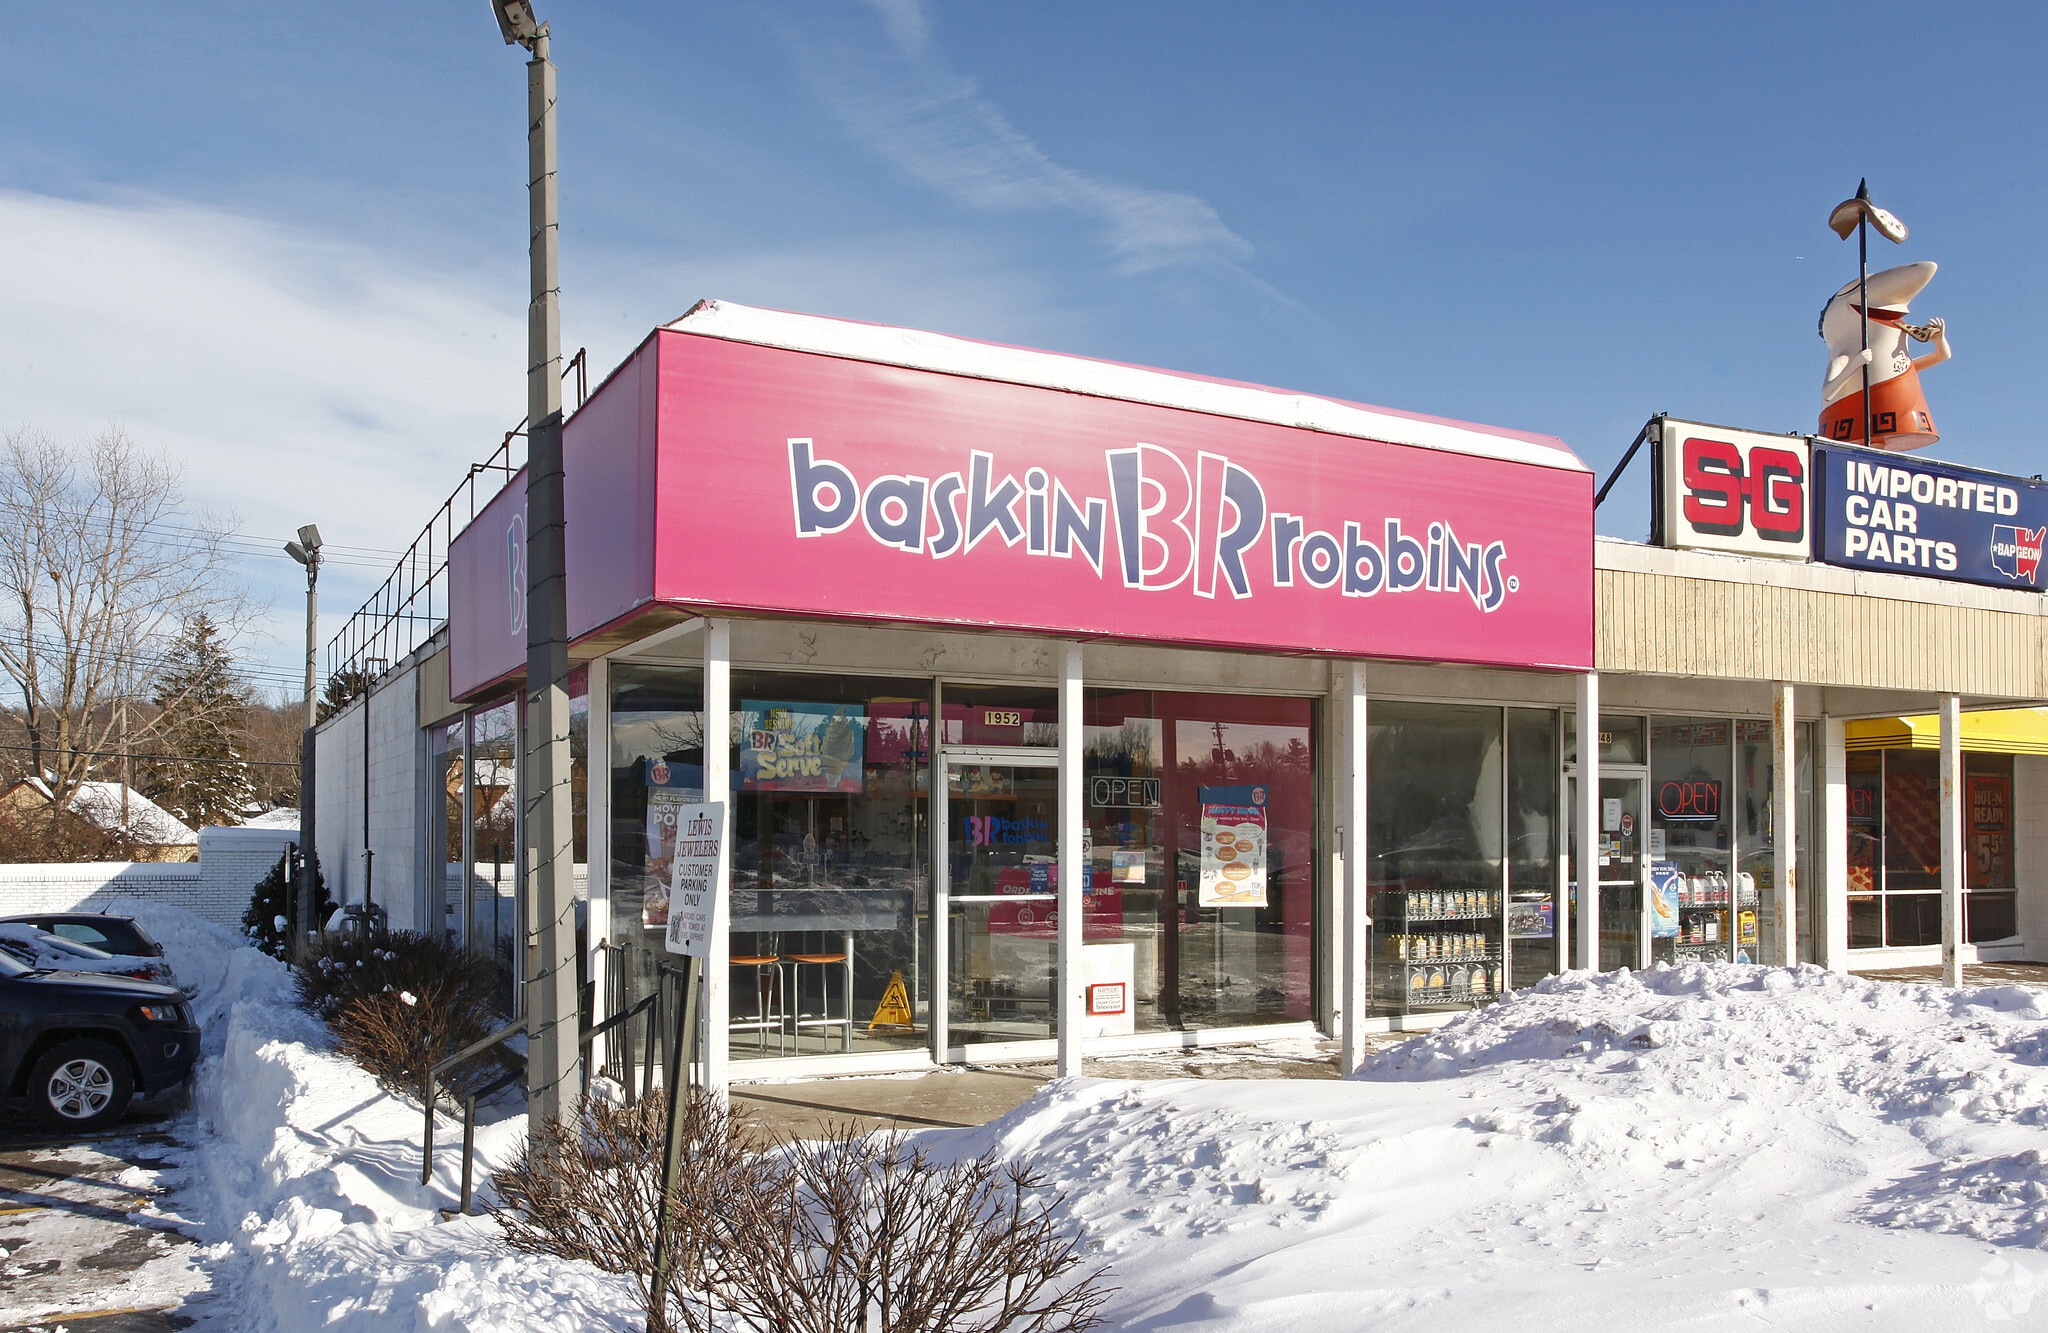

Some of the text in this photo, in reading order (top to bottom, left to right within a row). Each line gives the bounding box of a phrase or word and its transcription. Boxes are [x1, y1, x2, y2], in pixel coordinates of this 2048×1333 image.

[1846, 460, 2019, 516] IMPORTED
[1845, 495, 1918, 534] CAR
[787, 438, 1107, 580] baskin
[1105, 442, 1266, 600] BR
[1270, 512, 1508, 613] robbins
[1845, 527, 1958, 571] PARTS
[507, 514, 527, 636] B
[987, 712, 1019, 725] 1952
[752, 731, 821, 756] BR Soft
[1600, 733, 1611, 743] 48
[652, 766, 670, 781] BR
[757, 752, 822, 779] Serve
[1094, 779, 1158, 805] OPEN
[1659, 782, 1718, 815] OPEN
[1846, 788, 1873, 815] PEN
[653, 804, 679, 813] MOVI
[653, 812, 676, 826] PO
[1974, 807, 2005, 823] READY
[687, 819, 713, 836] LEWIS
[963, 815, 999, 847] BR
[677, 840, 719, 858] JEWELERS
[679, 863, 713, 877] CUSTOMER
[680, 878, 708, 892] PARKING
[684, 893, 701, 907] ONLY
